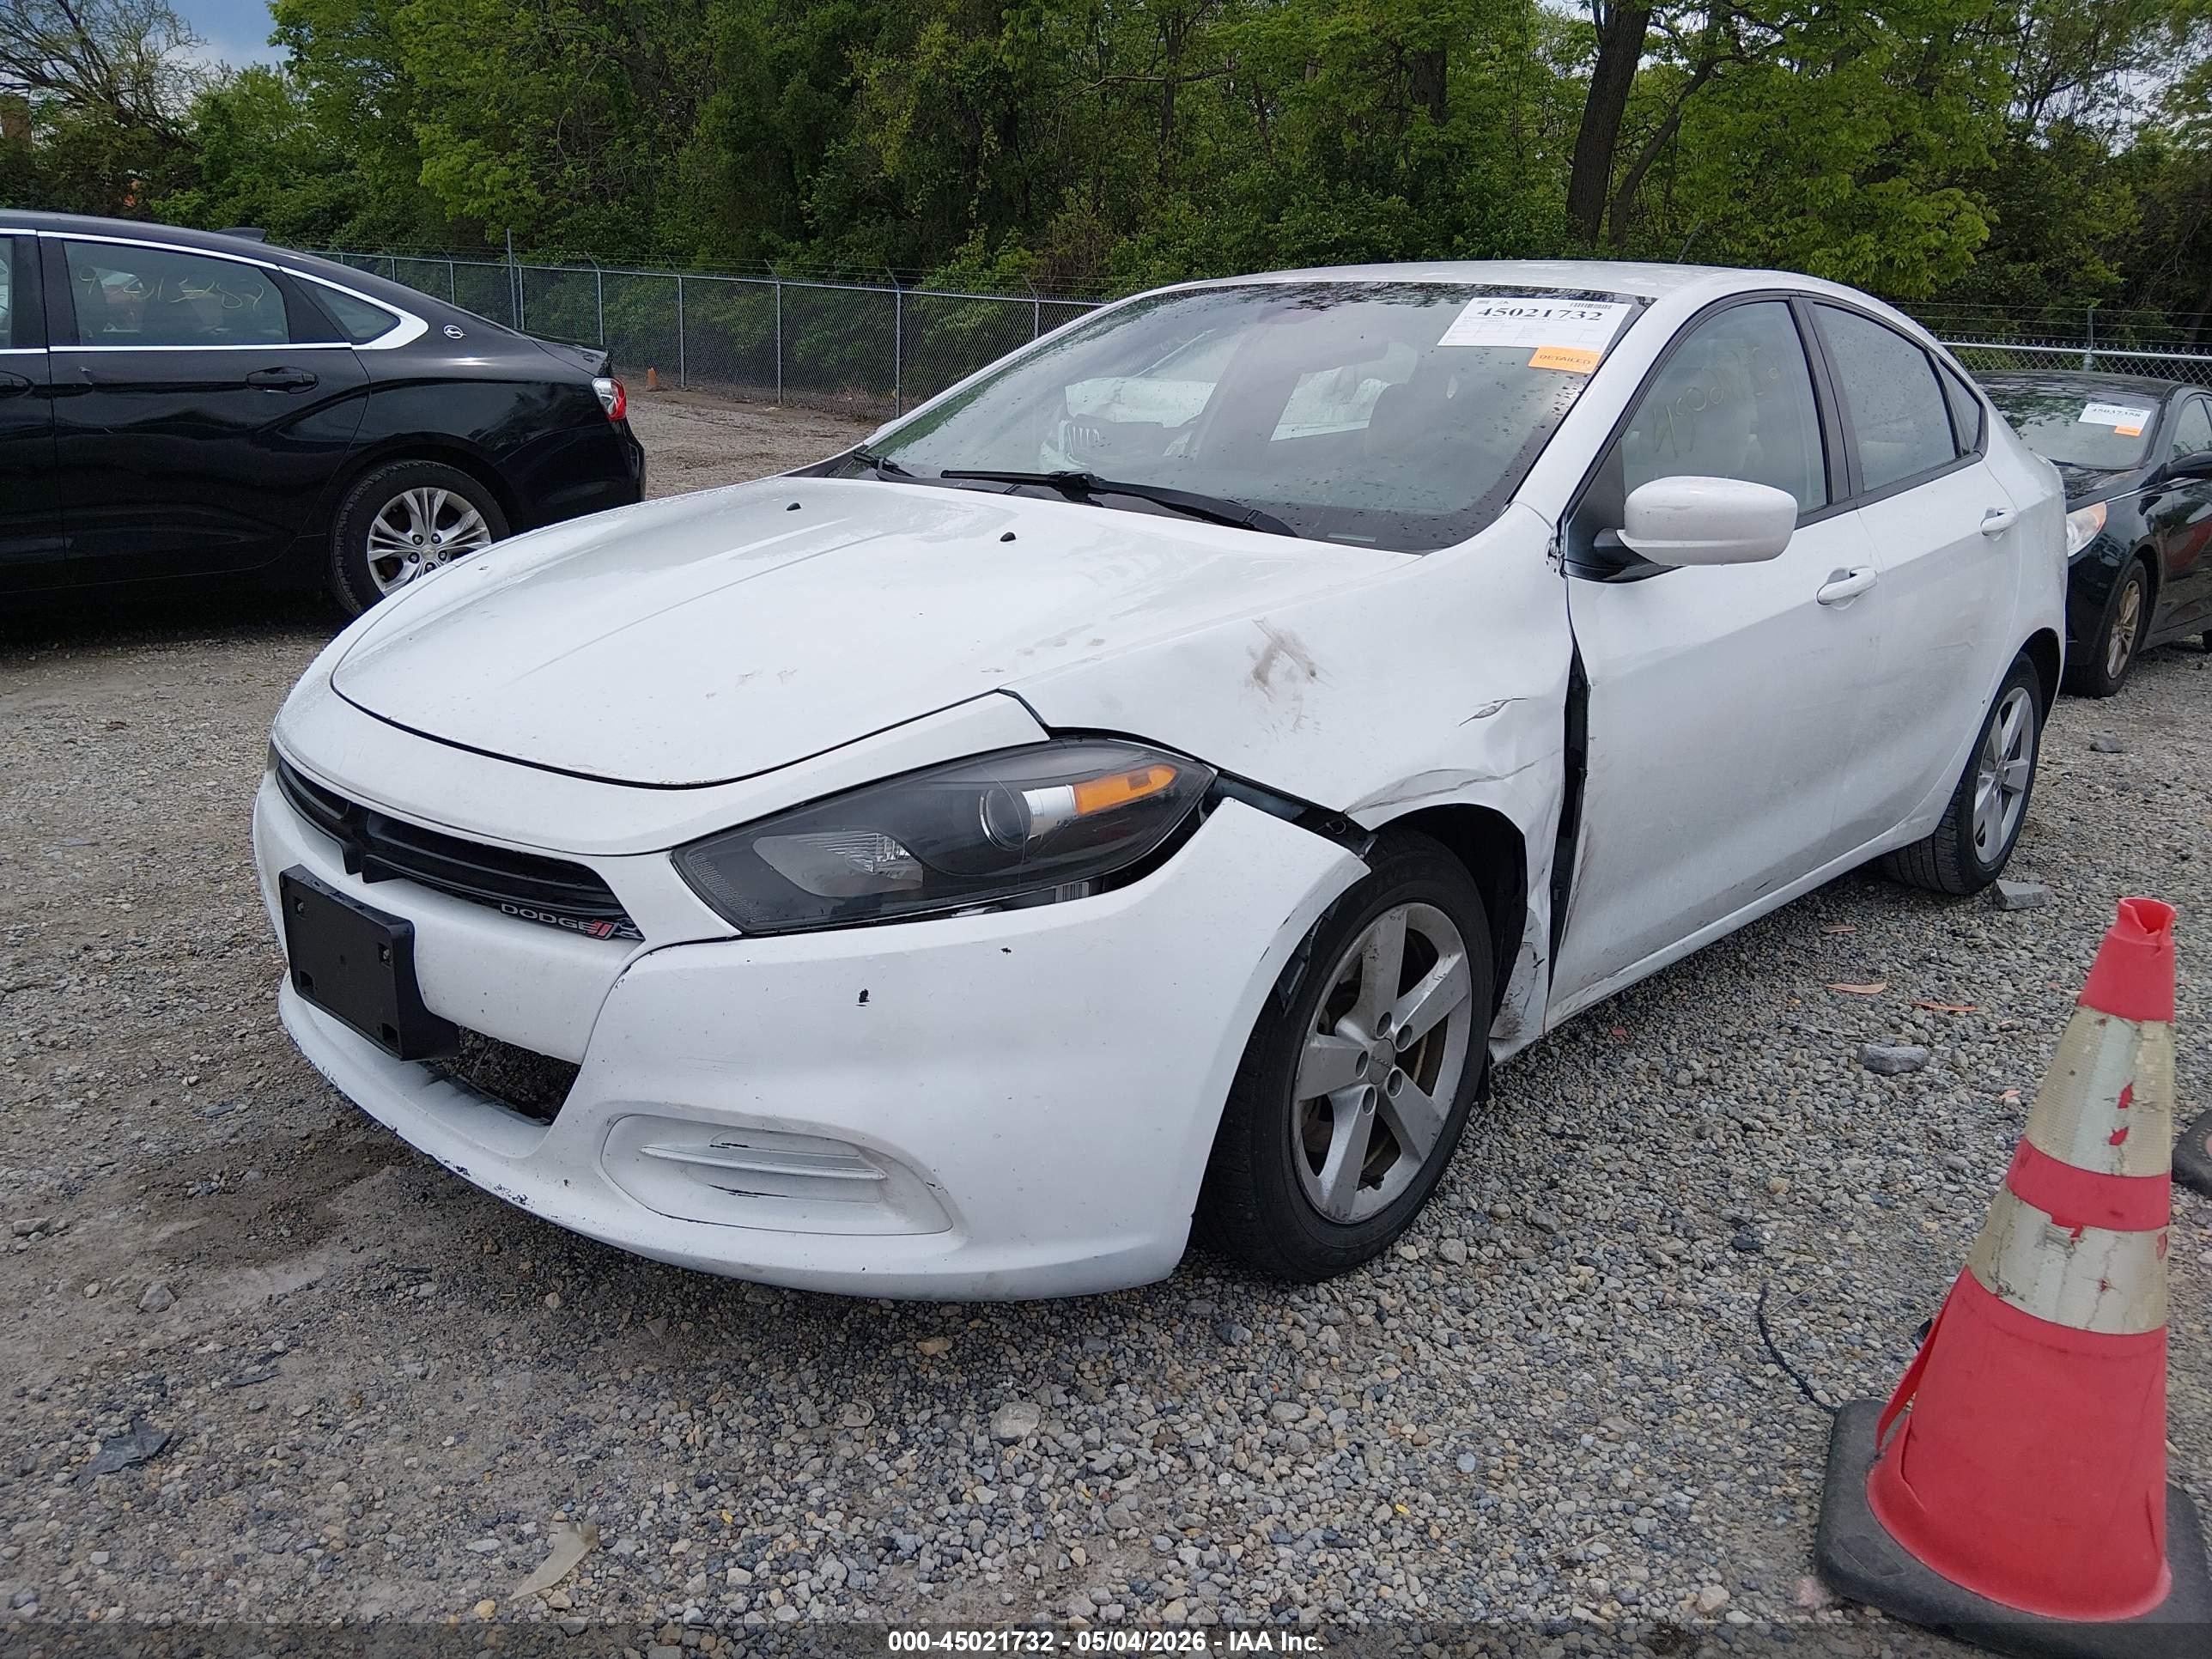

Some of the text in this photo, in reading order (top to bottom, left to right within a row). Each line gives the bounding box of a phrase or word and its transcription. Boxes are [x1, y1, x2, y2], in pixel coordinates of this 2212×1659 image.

[1477, 307, 1604, 321] 45021732
[1539, 354, 1591, 366] DETAILED
[501, 902, 596, 932] DODGE
